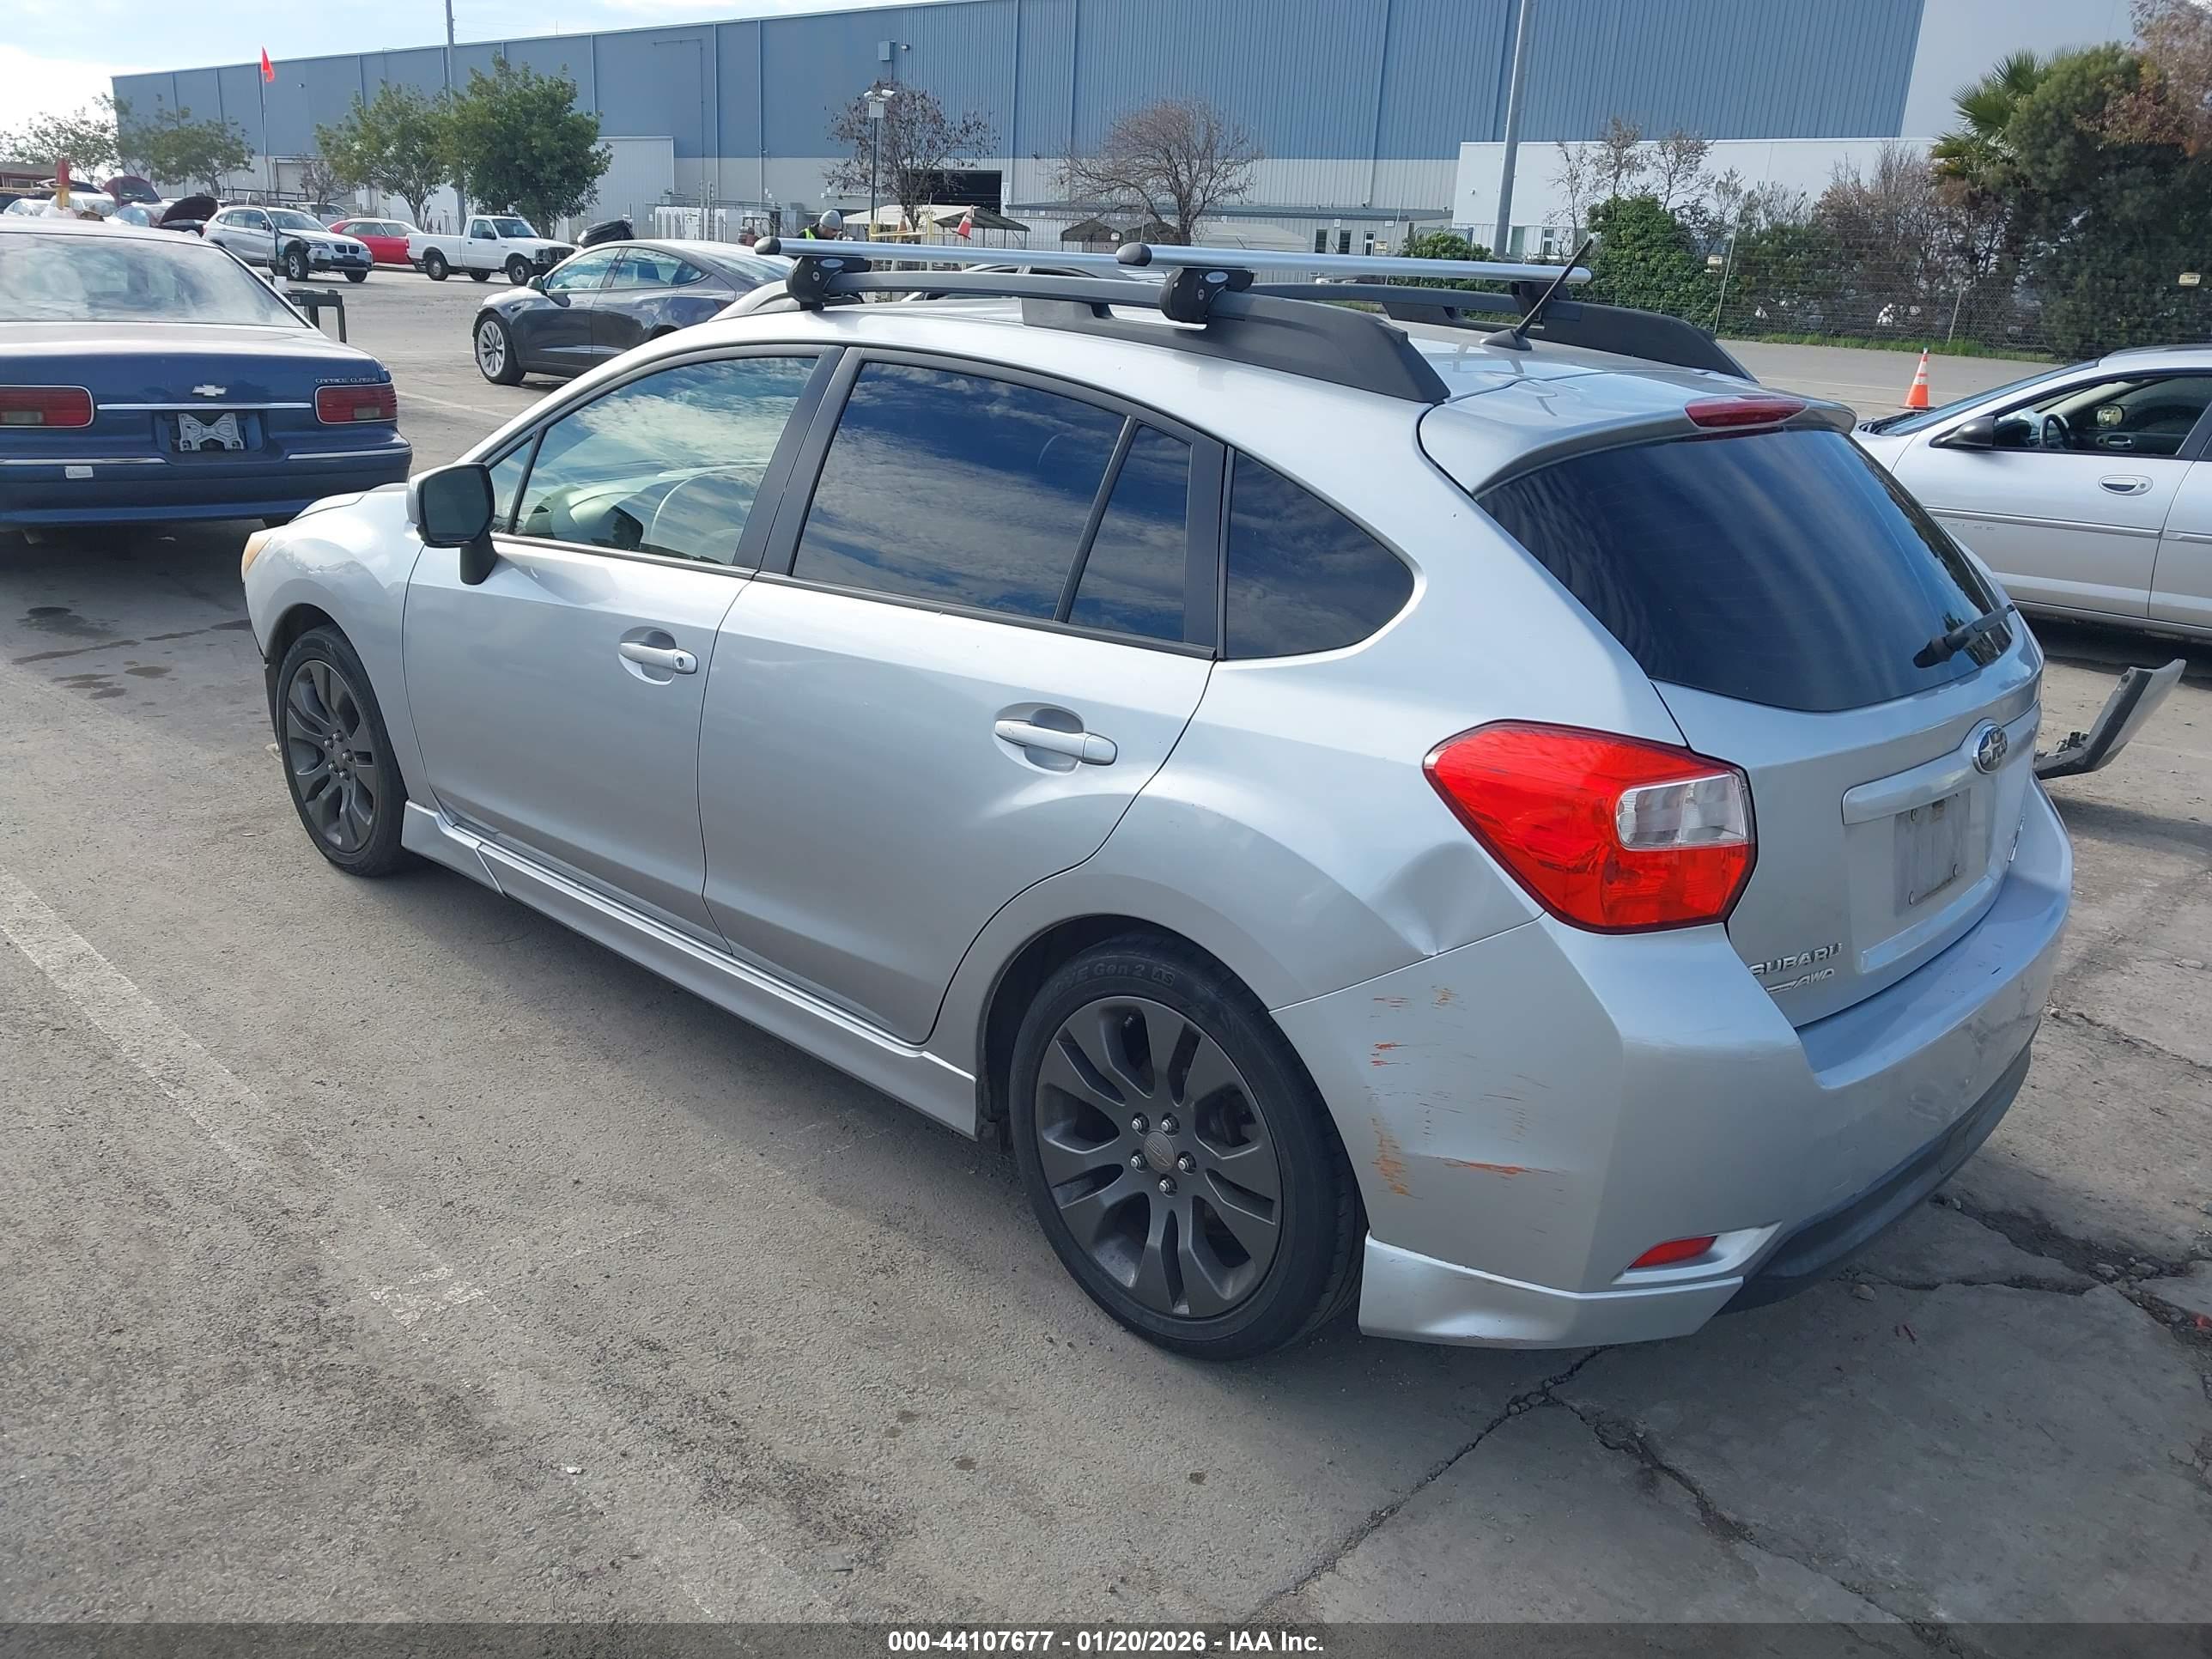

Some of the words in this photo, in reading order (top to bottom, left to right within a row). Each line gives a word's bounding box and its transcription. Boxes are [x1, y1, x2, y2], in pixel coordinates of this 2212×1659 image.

[1093, 962, 1128, 976] Gen
[1133, 963, 1146, 977] 2
[1748, 943, 1843, 975] SUBARU
[1792, 968, 1835, 989] AWD
